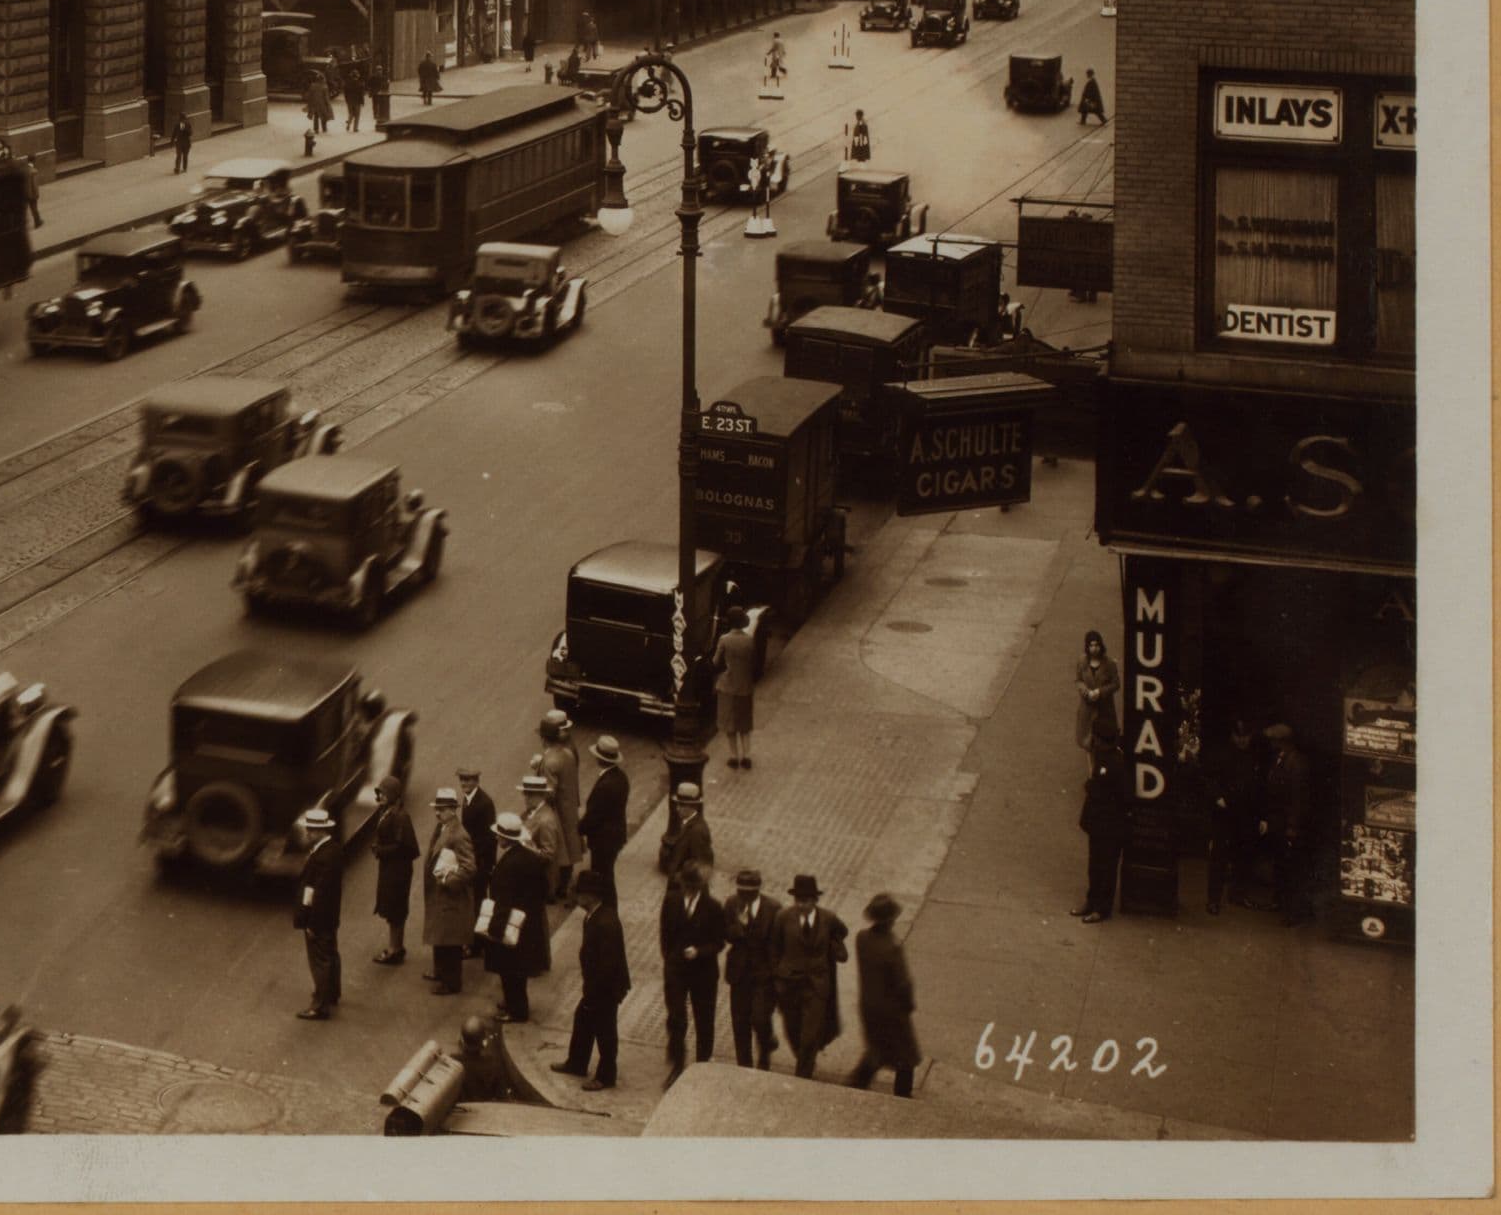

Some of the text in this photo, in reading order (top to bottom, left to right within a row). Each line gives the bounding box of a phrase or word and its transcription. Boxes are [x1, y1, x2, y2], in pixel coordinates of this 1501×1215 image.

[1224, 95, 1334, 129] INLAYS
[1224, 309, 1331, 339] DENTIST
[916, 464, 1016, 498] CIGARS
[1133, 586, 1165, 800] MURAD
